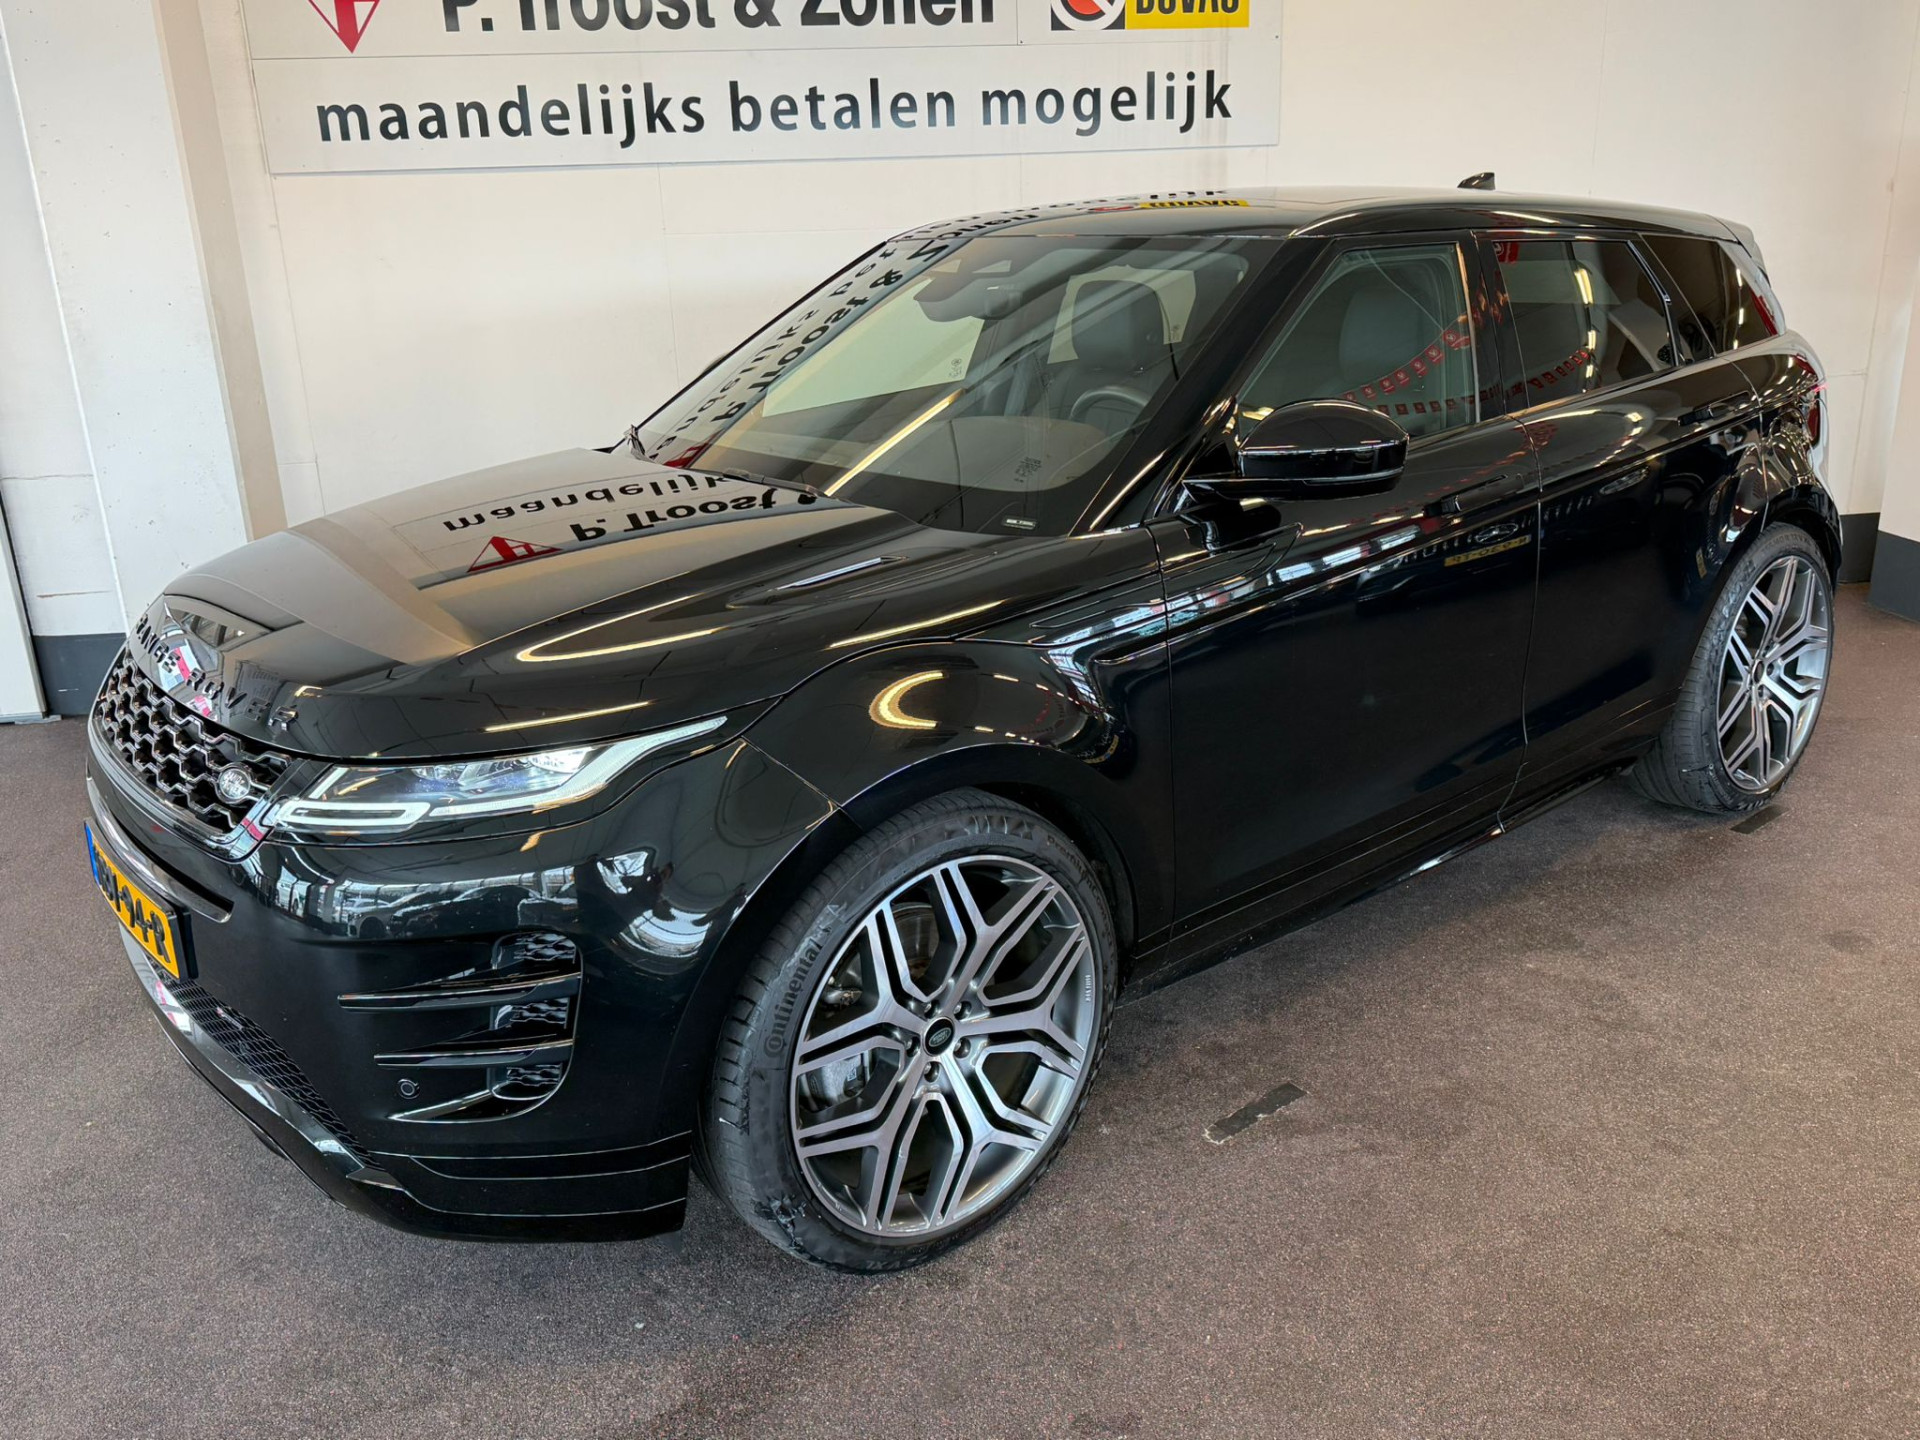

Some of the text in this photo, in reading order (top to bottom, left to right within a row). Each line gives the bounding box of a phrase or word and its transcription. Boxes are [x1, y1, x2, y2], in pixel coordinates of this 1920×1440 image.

[316, 69, 1232, 149] maandelijks betalen mogelijk
[136, 614, 181, 673] RANGE
[764, 937, 823, 1058] Continental
